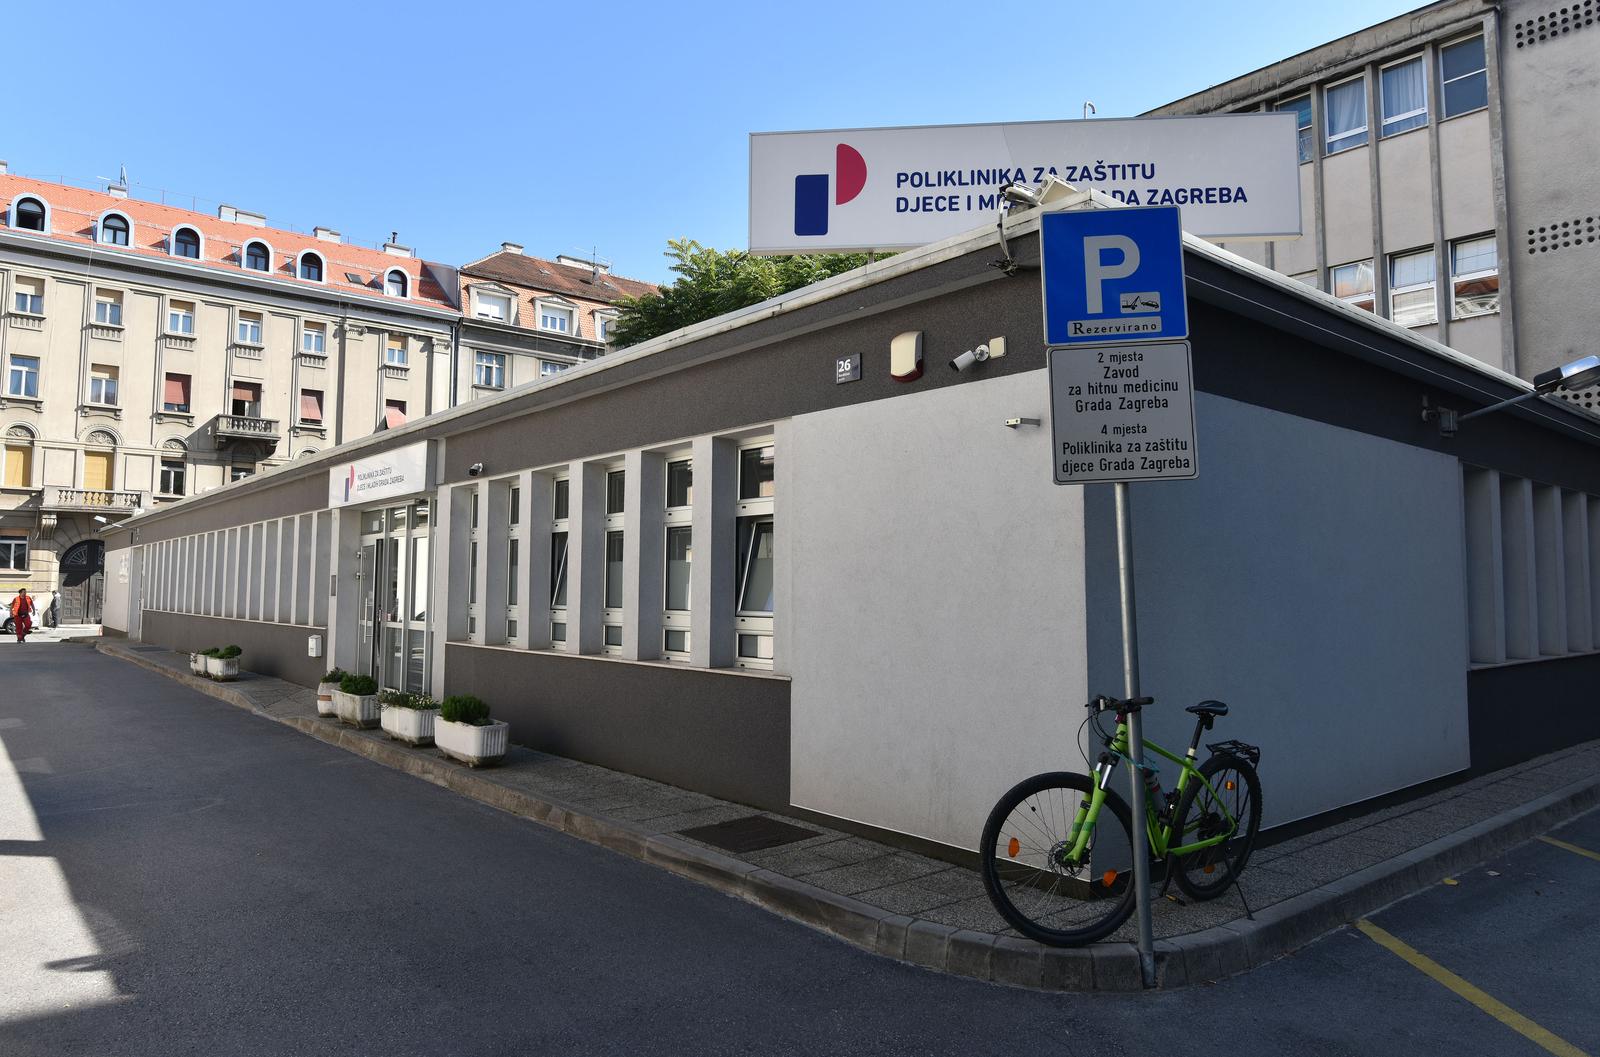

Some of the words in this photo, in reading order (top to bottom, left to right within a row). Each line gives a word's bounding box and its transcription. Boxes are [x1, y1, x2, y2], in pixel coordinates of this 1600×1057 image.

[896, 167, 1026, 188] POLIKLINIKA
[1066, 160, 1155, 182] ZAŠTITU
[896, 195, 960, 213] DJECE
[967, 194, 972, 211] I
[1146, 186, 1248, 206] ZAGREBA
[1083, 234, 1140, 314] P
[1072, 322, 1157, 335] Rezervirano
[838, 358, 851, 372] 26
[1098, 352, 1104, 363] 2
[1109, 351, 1143, 365] mjesta
[1103, 365, 1139, 379] Zavod
[1068, 386, 1082, 396] za
[1088, 382, 1118, 395] hitnu
[1123, 379, 1179, 394] medicinu
[1075, 398, 1112, 413] Grada
[1119, 396, 1169, 412] Zagreba
[1101, 424, 1108, 435] 4
[1113, 423, 1147, 437] mjesta
[1062, 441, 1122, 455] Poliklinika
[1127, 442, 1141, 453] za
[1145, 438, 1188, 452] zaštitu
[1062, 460, 1094, 476] djece
[1099, 457, 1135, 472] Grada
[1140, 456, 1190, 473] Zagreba
